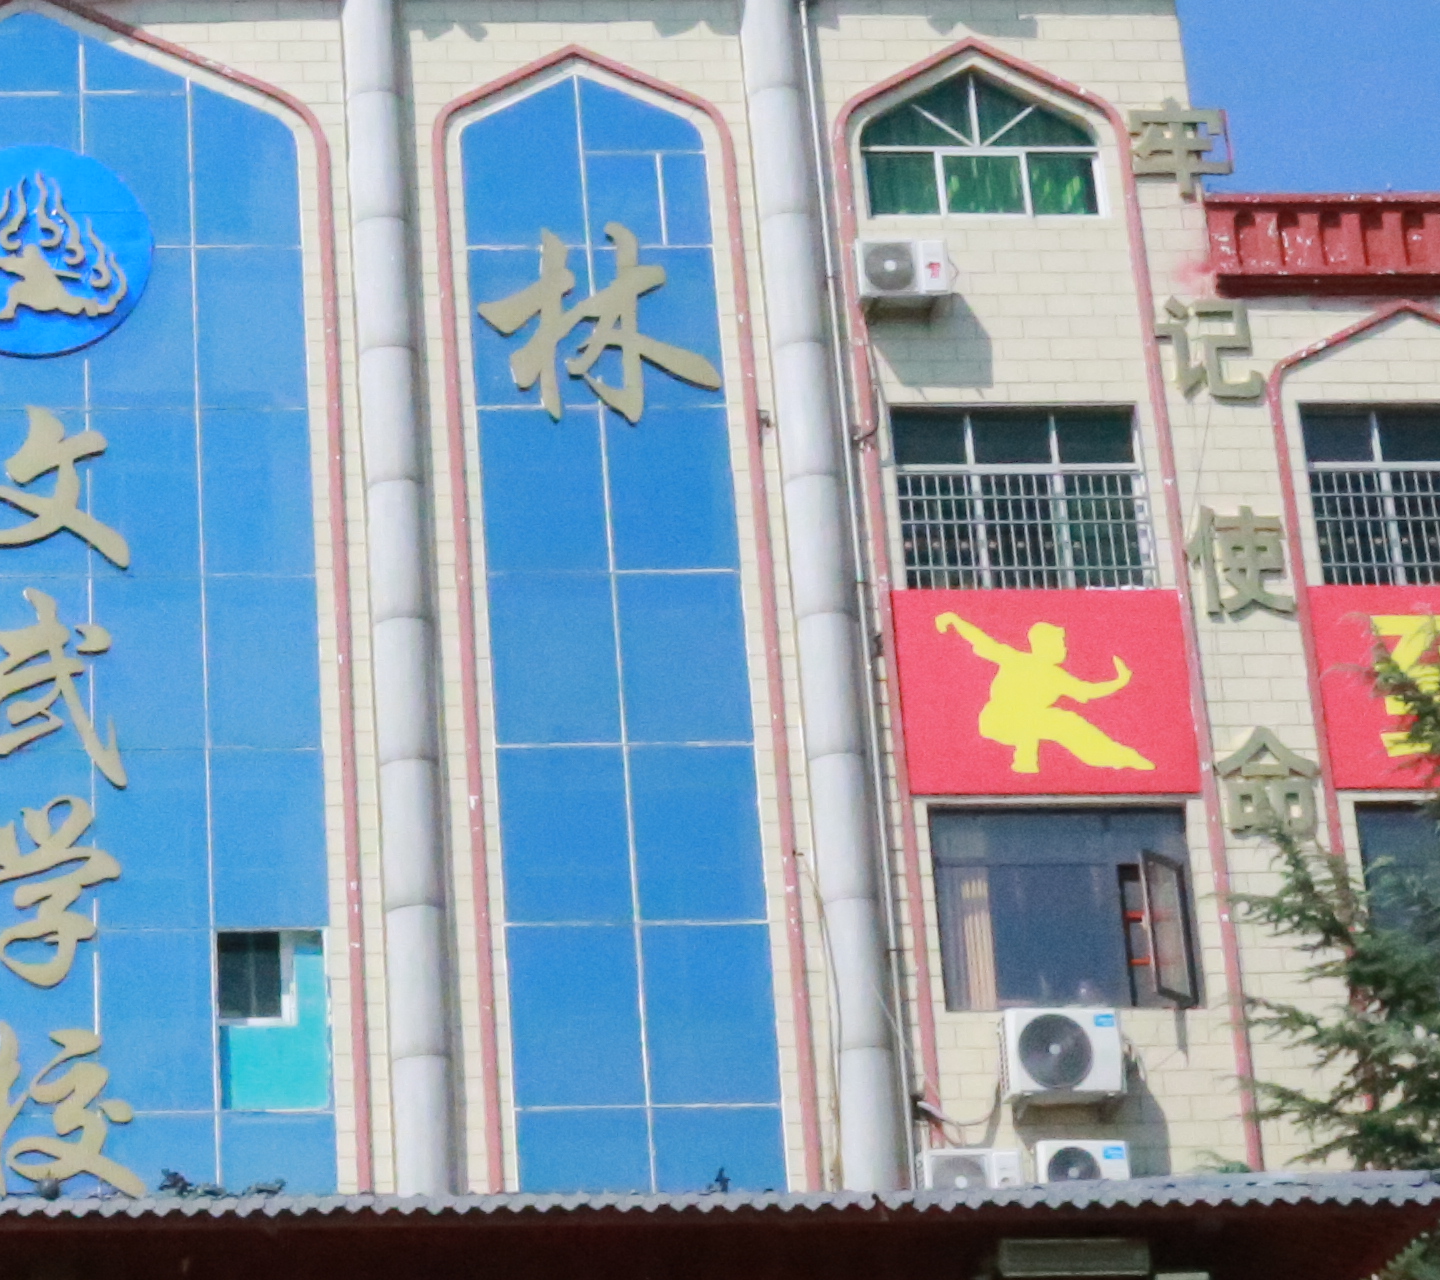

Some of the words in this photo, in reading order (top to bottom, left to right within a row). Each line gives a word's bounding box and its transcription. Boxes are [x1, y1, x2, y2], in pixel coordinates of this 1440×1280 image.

[477, 222, 721, 424] 林
[1129, 98, 1318, 838] 牢记使命
